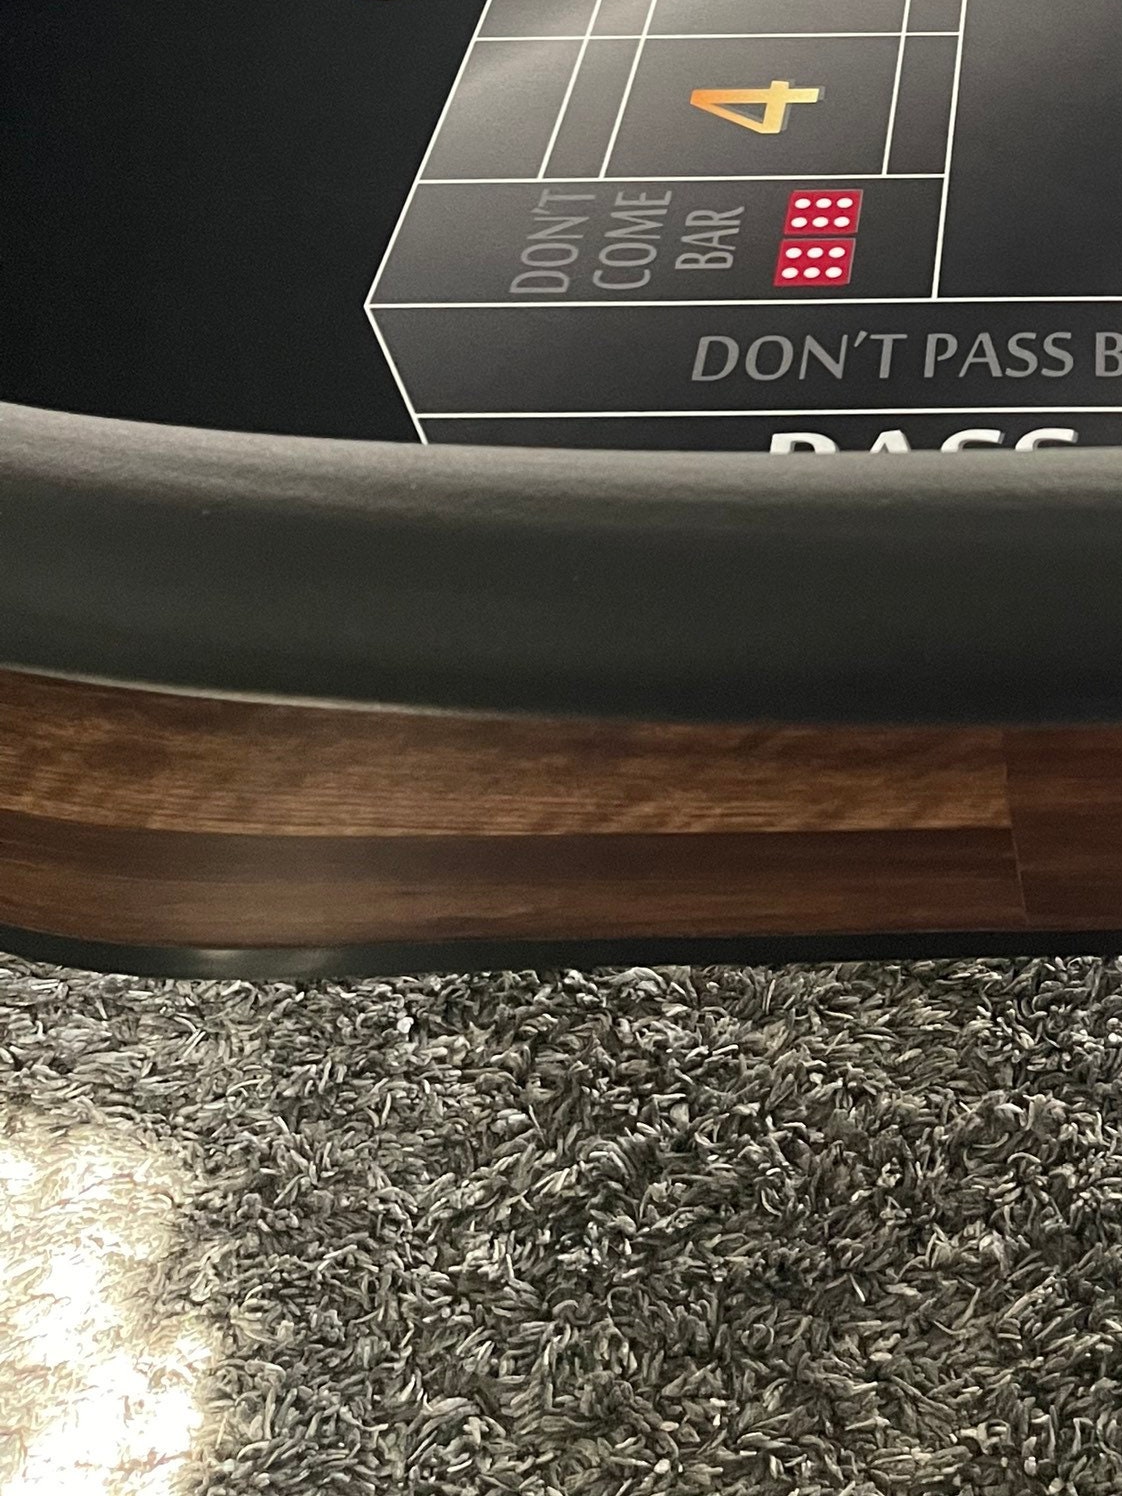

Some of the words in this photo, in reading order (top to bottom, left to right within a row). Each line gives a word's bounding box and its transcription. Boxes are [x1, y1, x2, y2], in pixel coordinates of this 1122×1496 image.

[690, 80, 825, 134] 4
[509, 188, 596, 294] DON'T
[592, 190, 673, 290] COME
[675, 206, 745, 270] BAR
[691, 330, 908, 381] DON'T
[923, 331, 1075, 379] PASS
